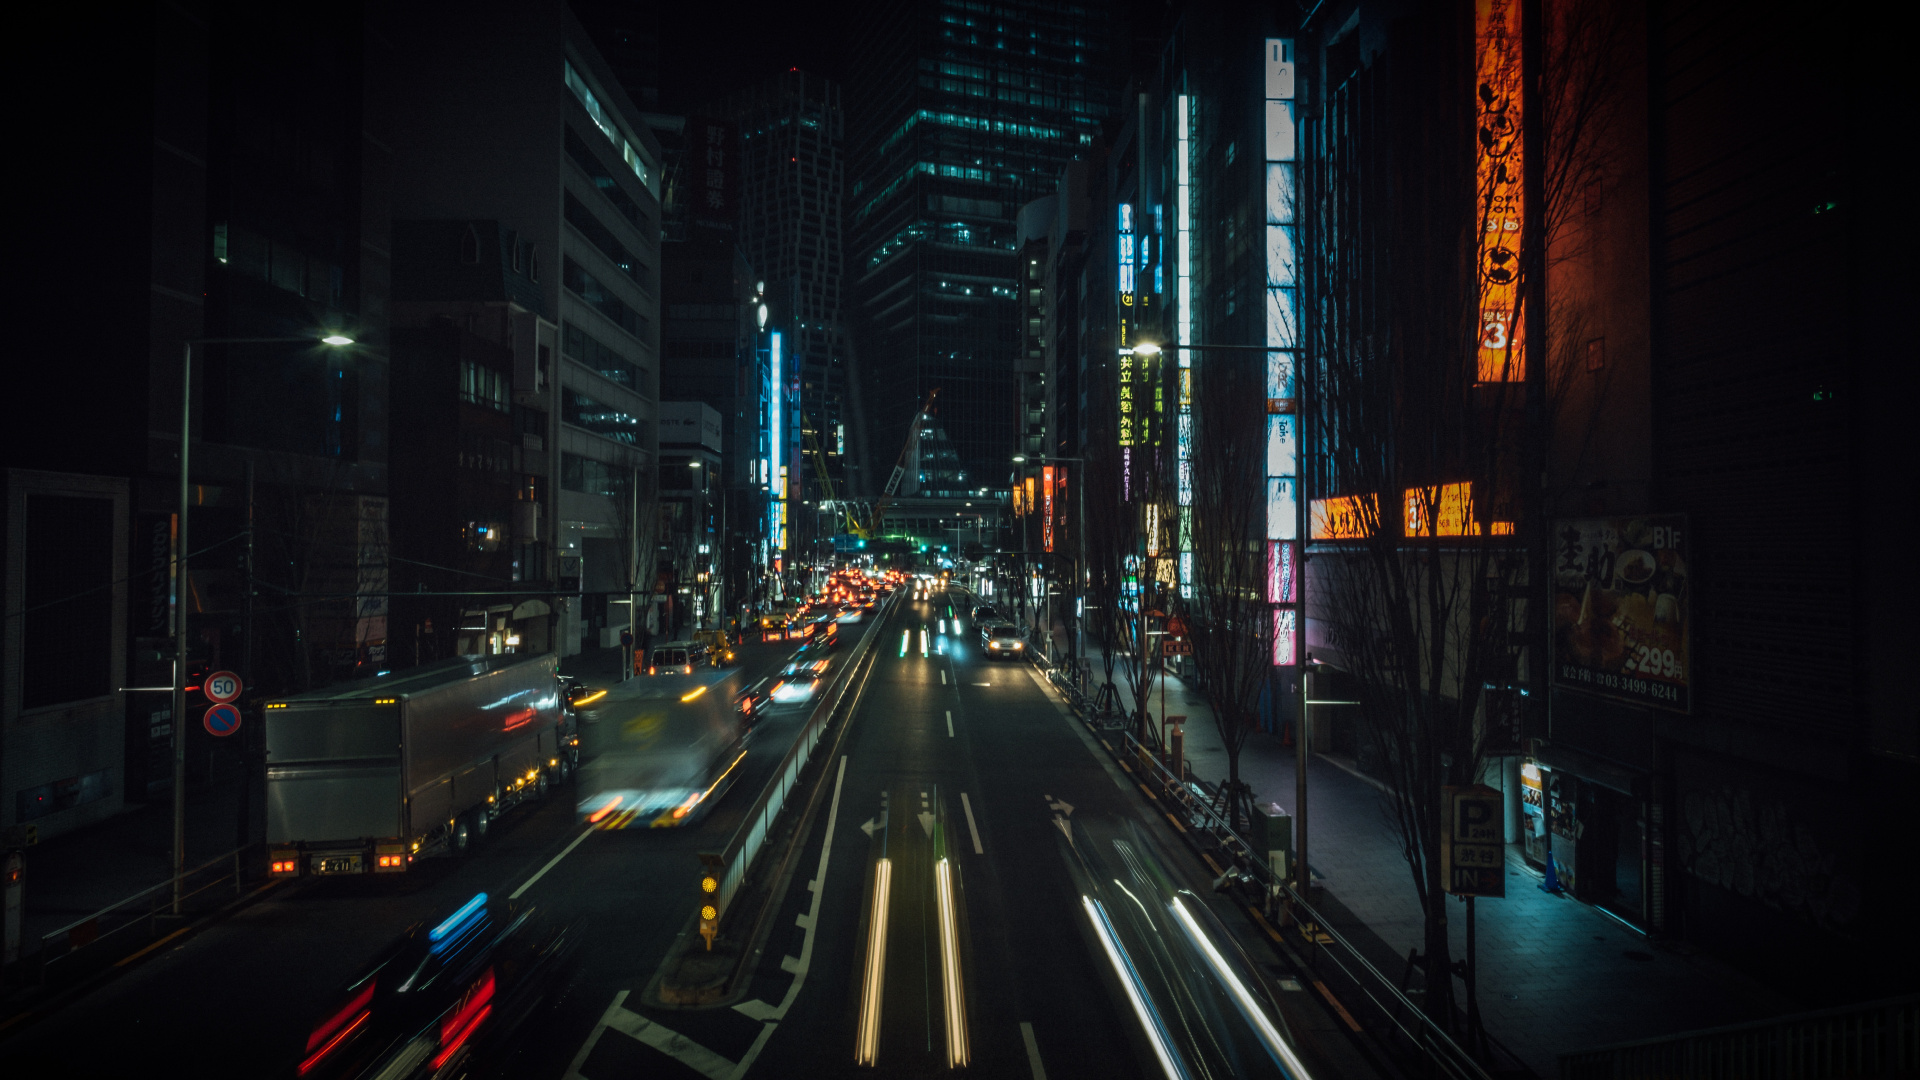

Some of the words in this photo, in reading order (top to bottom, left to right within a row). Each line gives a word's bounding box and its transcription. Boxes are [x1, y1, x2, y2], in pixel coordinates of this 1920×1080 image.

[707, 125, 725, 209] 野村證券
[1653, 526, 1681, 550] B1F
[214, 680, 234, 695] 50
[1459, 799, 1493, 839] P
[1471, 828, 1496, 840] 24H
[1460, 847, 1495, 865] 渋谷
[1454, 869, 1479, 888] IN
